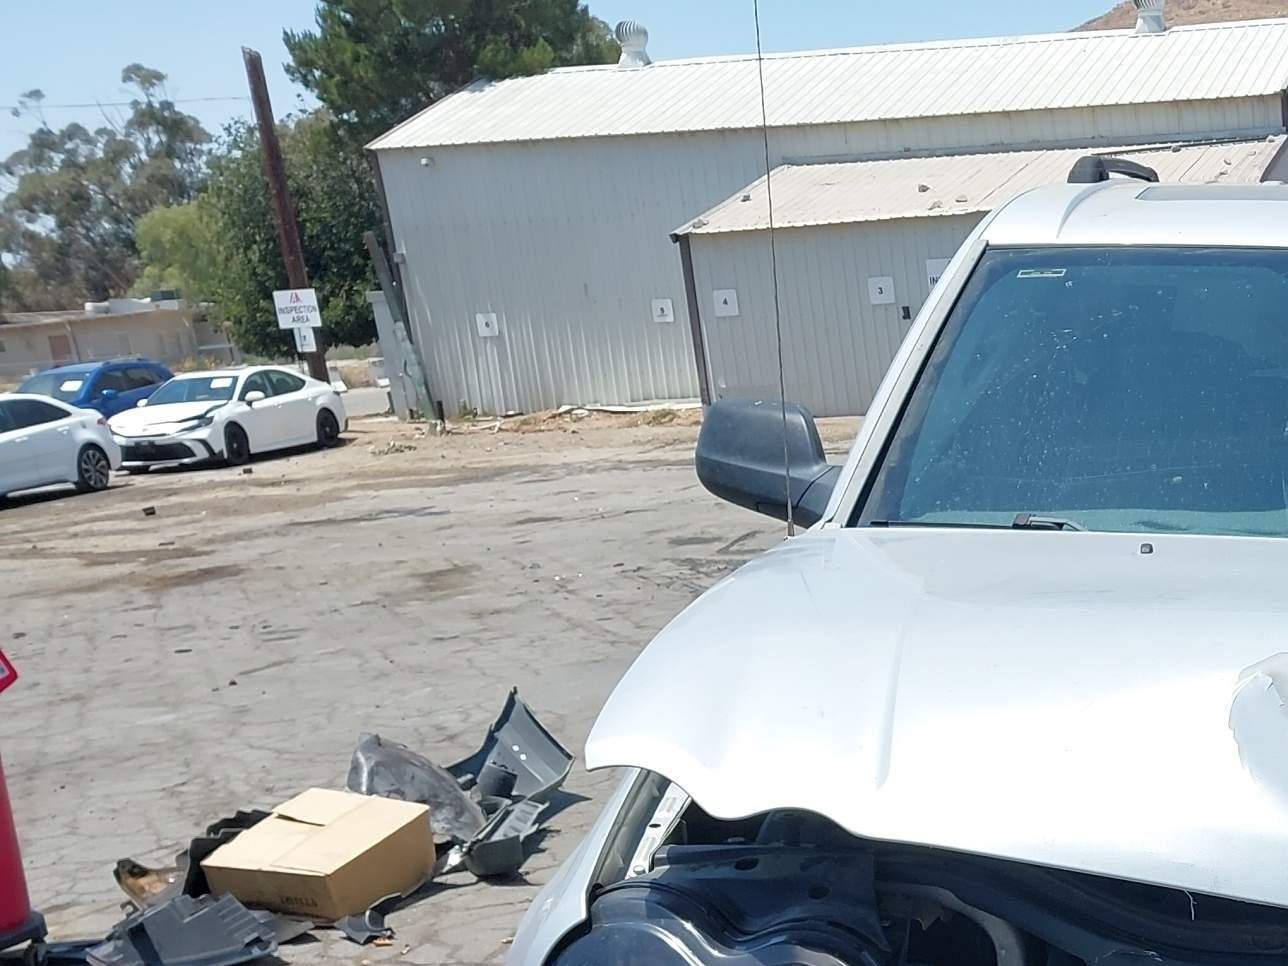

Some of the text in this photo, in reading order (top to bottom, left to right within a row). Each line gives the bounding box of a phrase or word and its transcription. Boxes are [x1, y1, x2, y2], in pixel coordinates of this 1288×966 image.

[877, 286, 884, 295] 3
[722, 297, 729, 306] 4
[279, 304, 317, 314] INSPECTION
[292, 315, 310, 323] AREA
